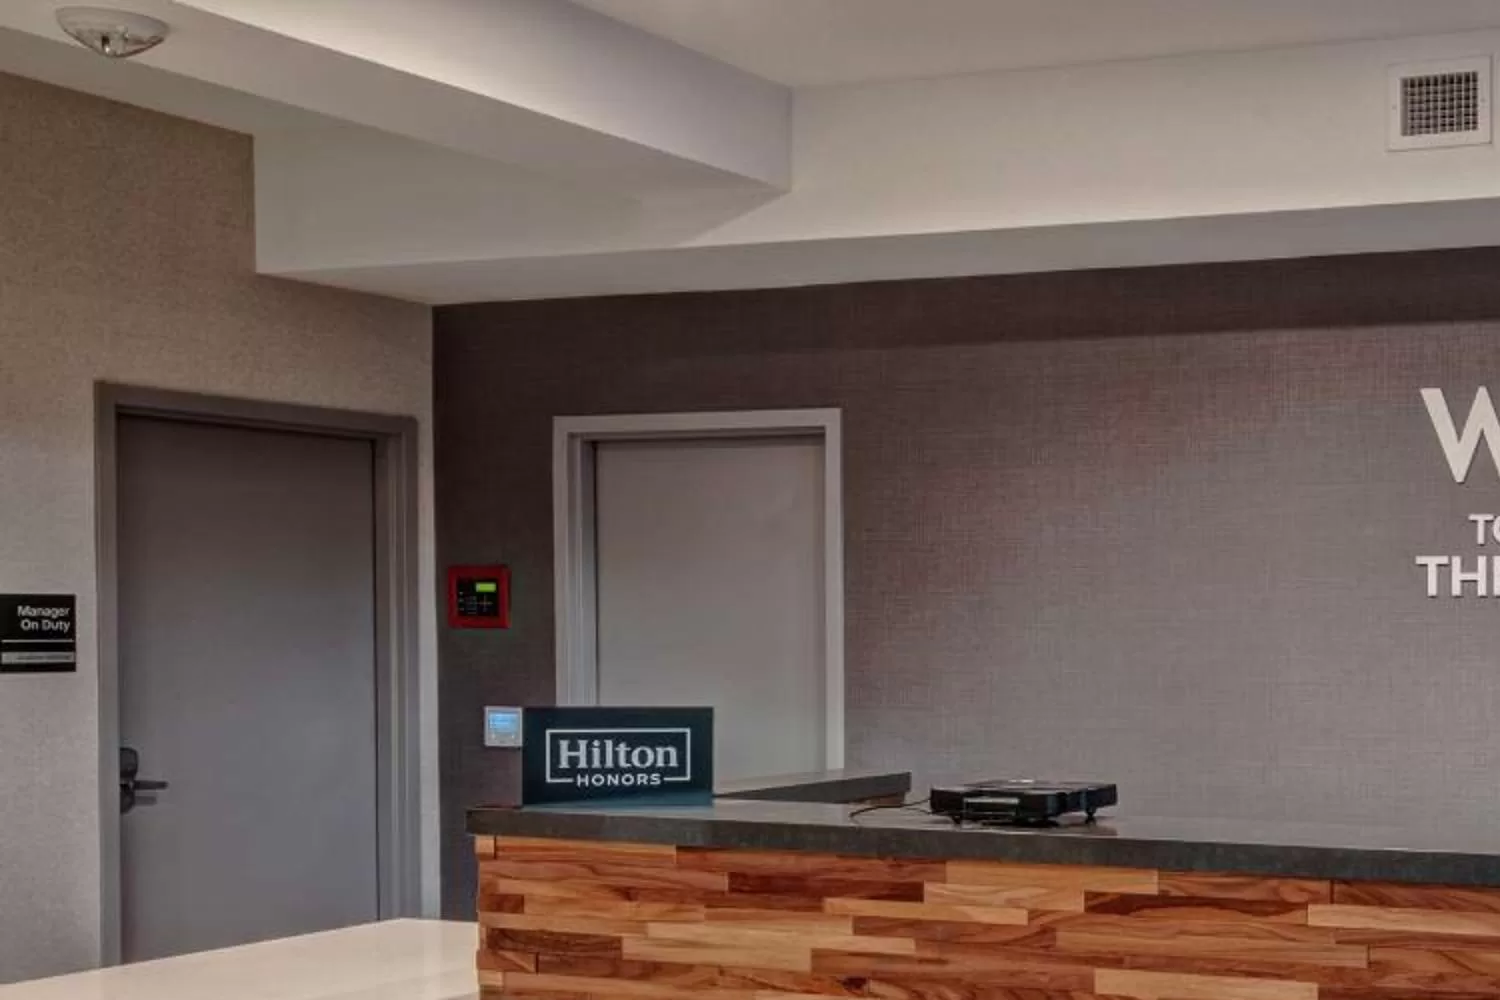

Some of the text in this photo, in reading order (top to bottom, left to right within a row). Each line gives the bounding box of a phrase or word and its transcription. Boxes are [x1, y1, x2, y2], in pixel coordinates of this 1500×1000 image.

[17, 605, 70, 619] Manager
[20, 618, 71, 633] On Duty
[558, 738, 679, 770] Hilton
[576, 772, 662, 787] HONORS
